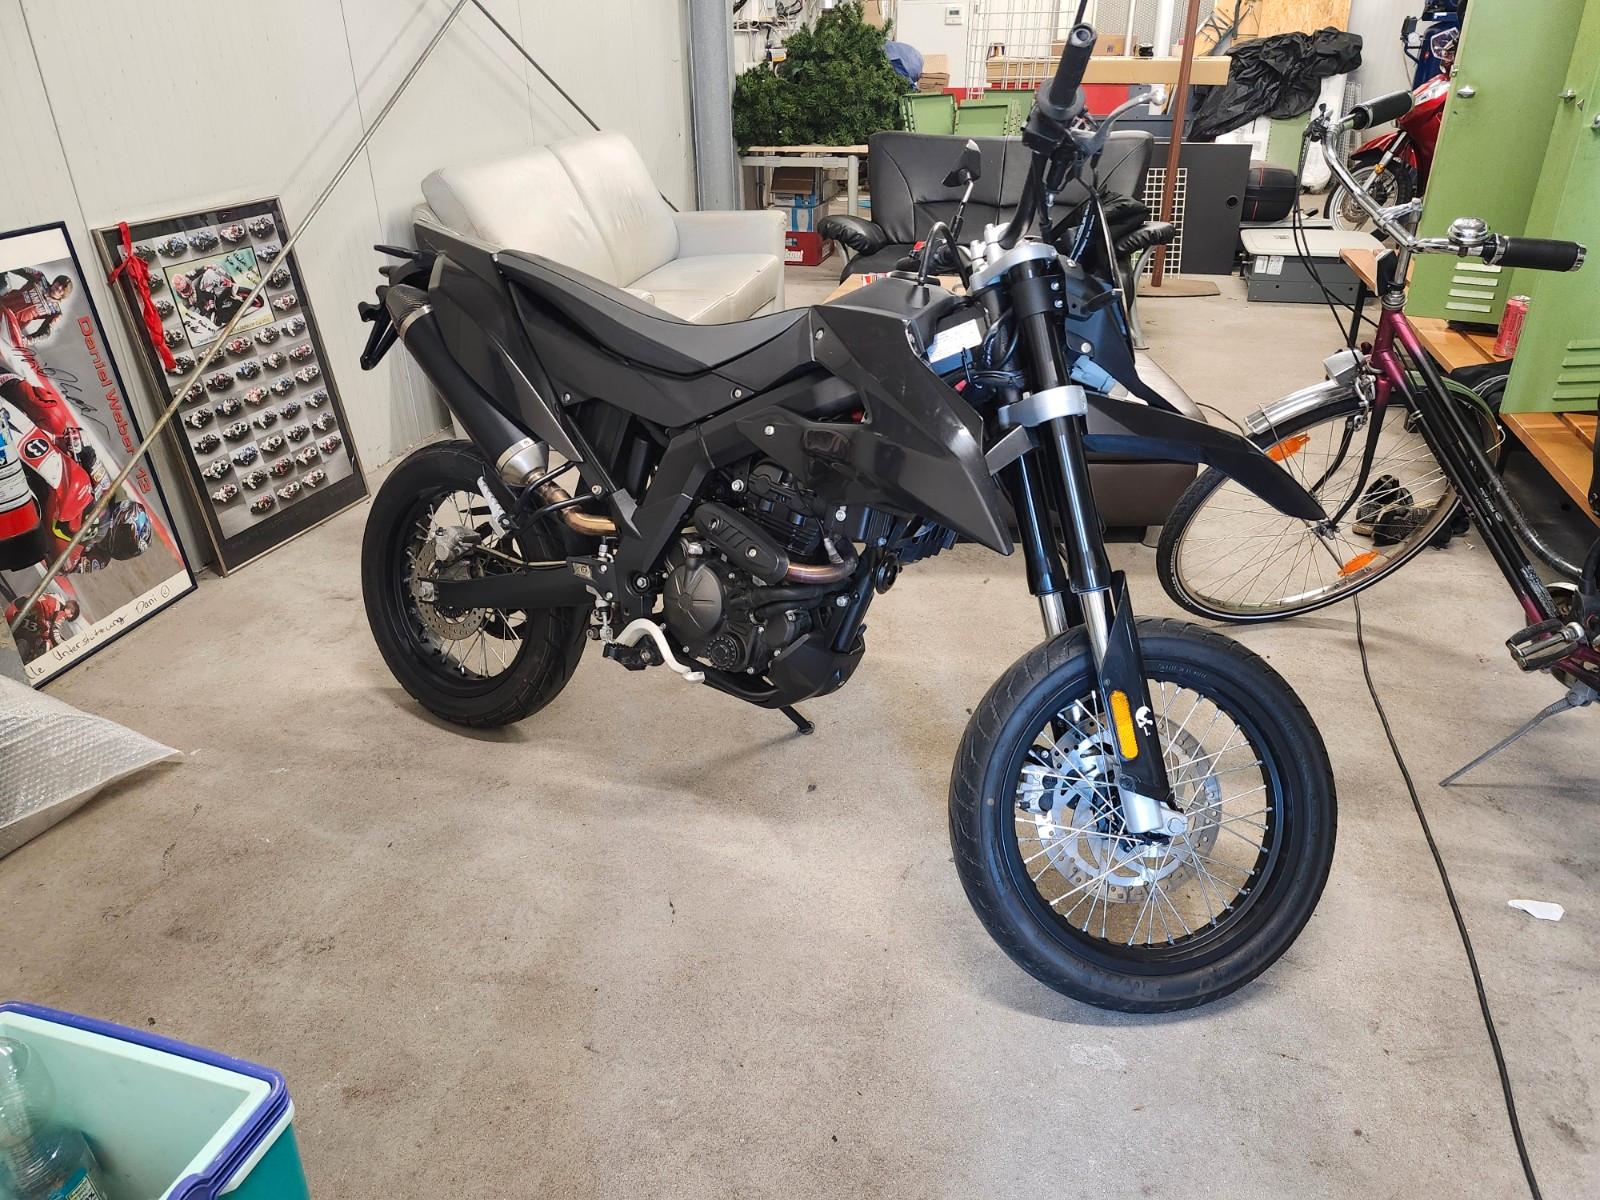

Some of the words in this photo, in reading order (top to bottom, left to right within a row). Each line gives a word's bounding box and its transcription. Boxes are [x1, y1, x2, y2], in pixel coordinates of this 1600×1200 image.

[26, 440, 48, 456] 13
[77, 316, 112, 387] Daniel
[105, 388, 135, 456] Weber
[135, 467, 152, 493] 13
